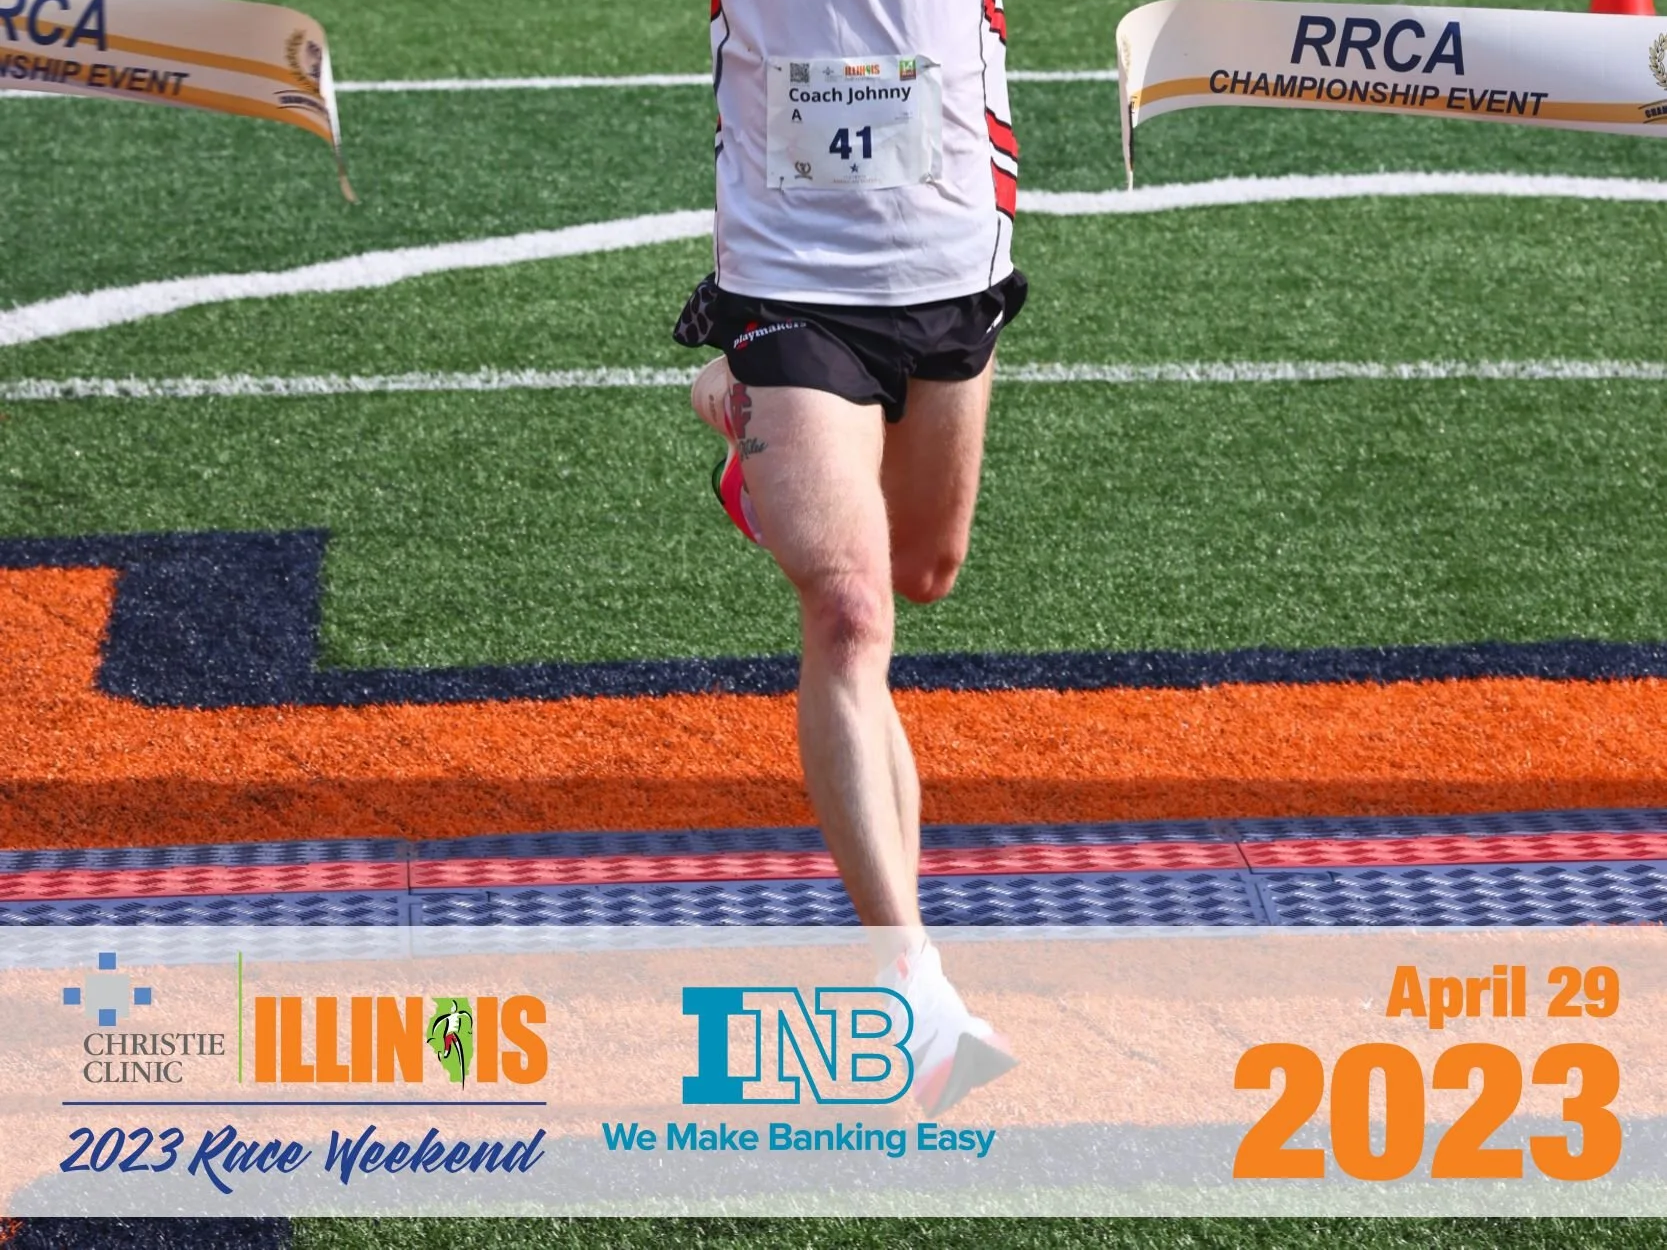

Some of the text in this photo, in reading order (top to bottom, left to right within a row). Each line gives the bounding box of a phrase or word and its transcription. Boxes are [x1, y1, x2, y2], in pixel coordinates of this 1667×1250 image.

[1290, 15, 1466, 77] RRCA
[87, 63, 190, 96] EVENT
[789, 86, 912, 106] Coach Johnny
[1208, 69, 1549, 117] CHAMPIONSHIP EVENT
[791, 108, 802, 121] A
[829, 125, 873, 160] 41
